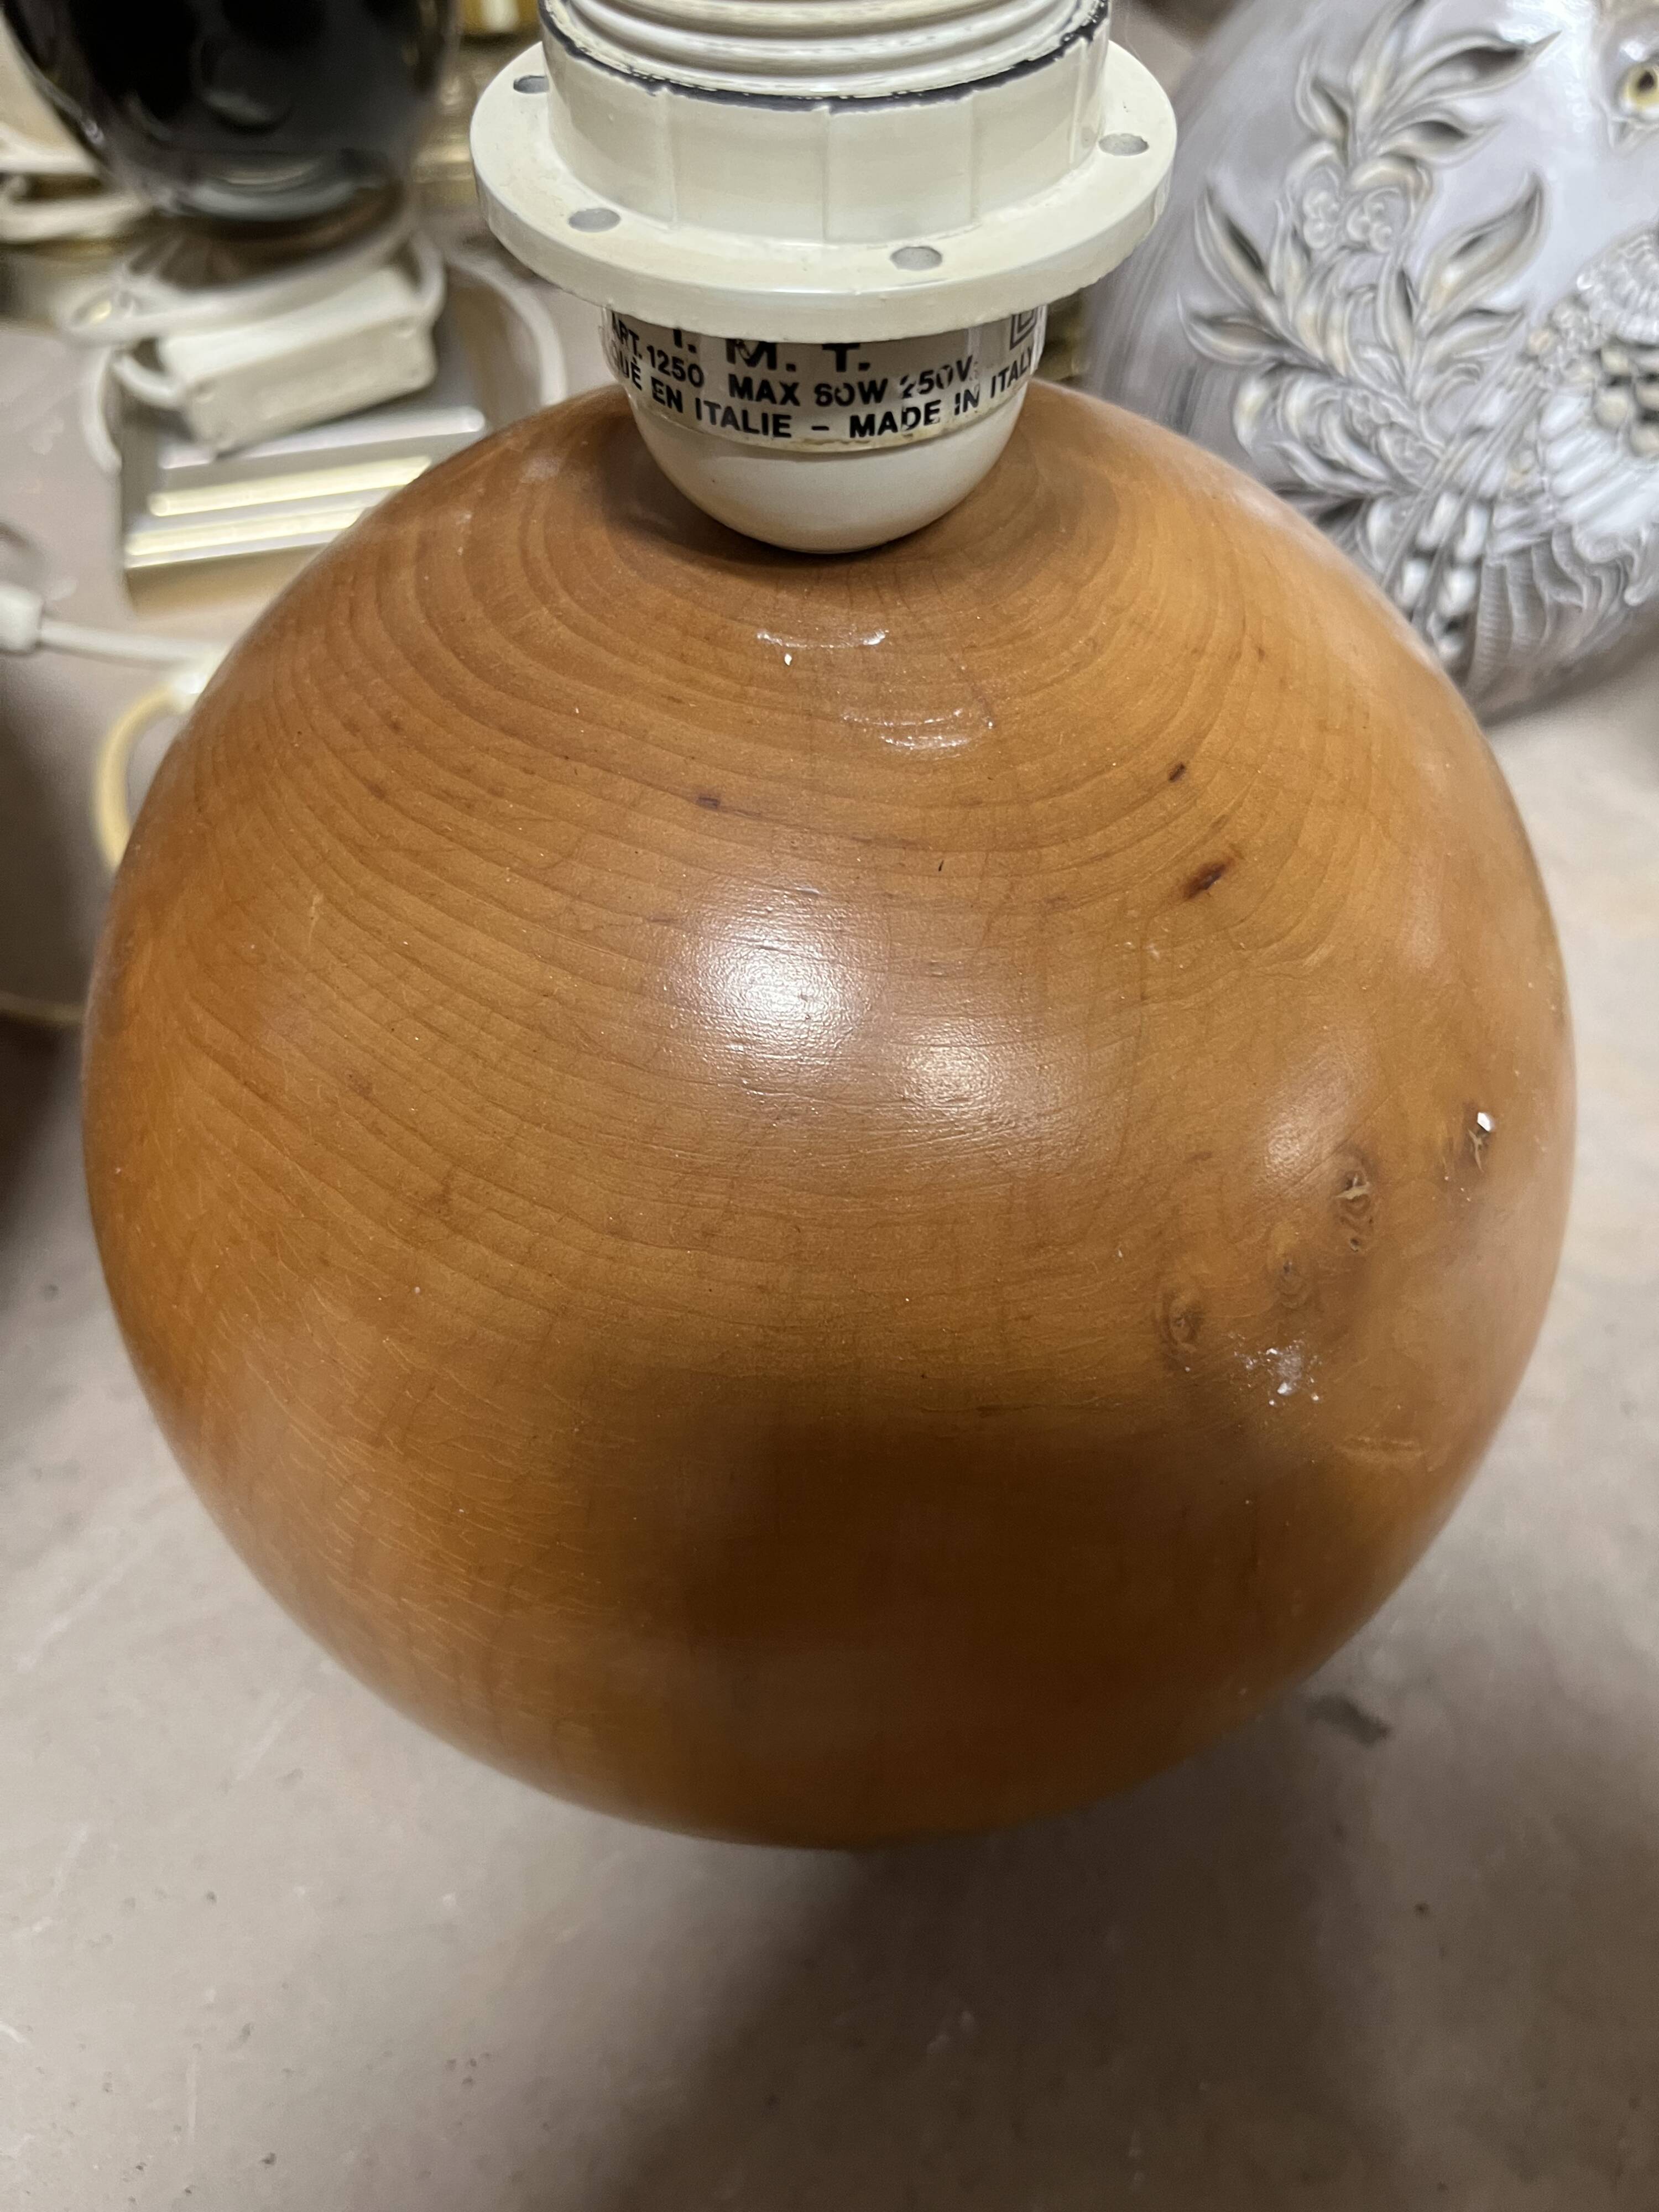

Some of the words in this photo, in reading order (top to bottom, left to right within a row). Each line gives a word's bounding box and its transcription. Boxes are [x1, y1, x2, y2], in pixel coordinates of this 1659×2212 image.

[646, 345, 705, 388] 1250
[728, 373, 801, 406] MAX
[726, 338, 796, 372] M.
[822, 343, 870, 373] T.
[651, 376, 684, 414] EN
[695, 398, 792, 438] ITALIE
[850, 399, 942, 439] MADE
[954, 385, 980, 416] IN
[990, 347, 1033, 399] ITALY
